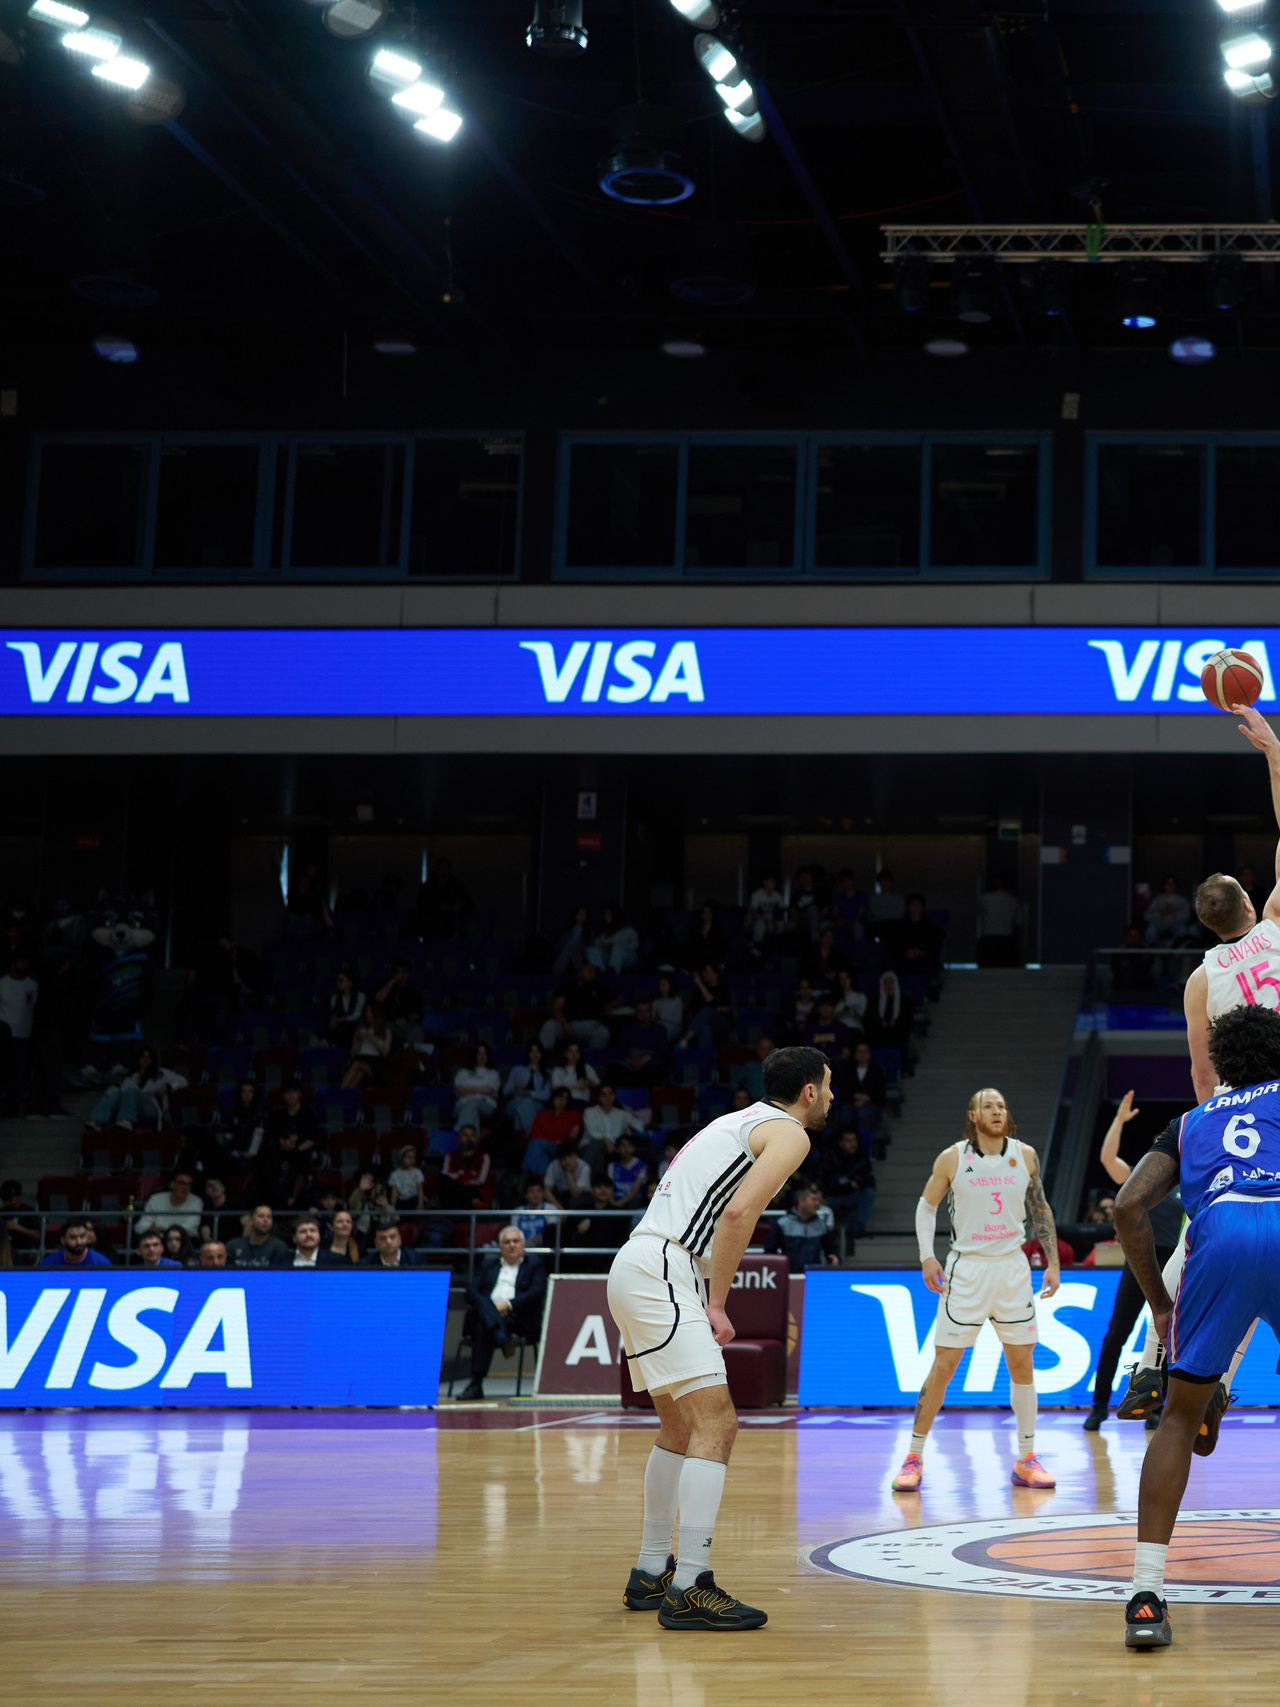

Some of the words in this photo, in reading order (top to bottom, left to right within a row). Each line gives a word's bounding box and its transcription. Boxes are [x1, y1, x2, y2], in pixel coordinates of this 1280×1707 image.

[7, 642, 190, 703] VISA
[519, 641, 704, 703] VISA
[1217, 932, 1272, 969] CAVARS
[1203, 1082, 1280, 1113] LAMAR
[1222, 1112, 1261, 1159] 6
[989, 1191, 1003, 1216] 3
[983, 1222, 1007, 1233] Bank
[0, 1286, 252, 1390] VISA
